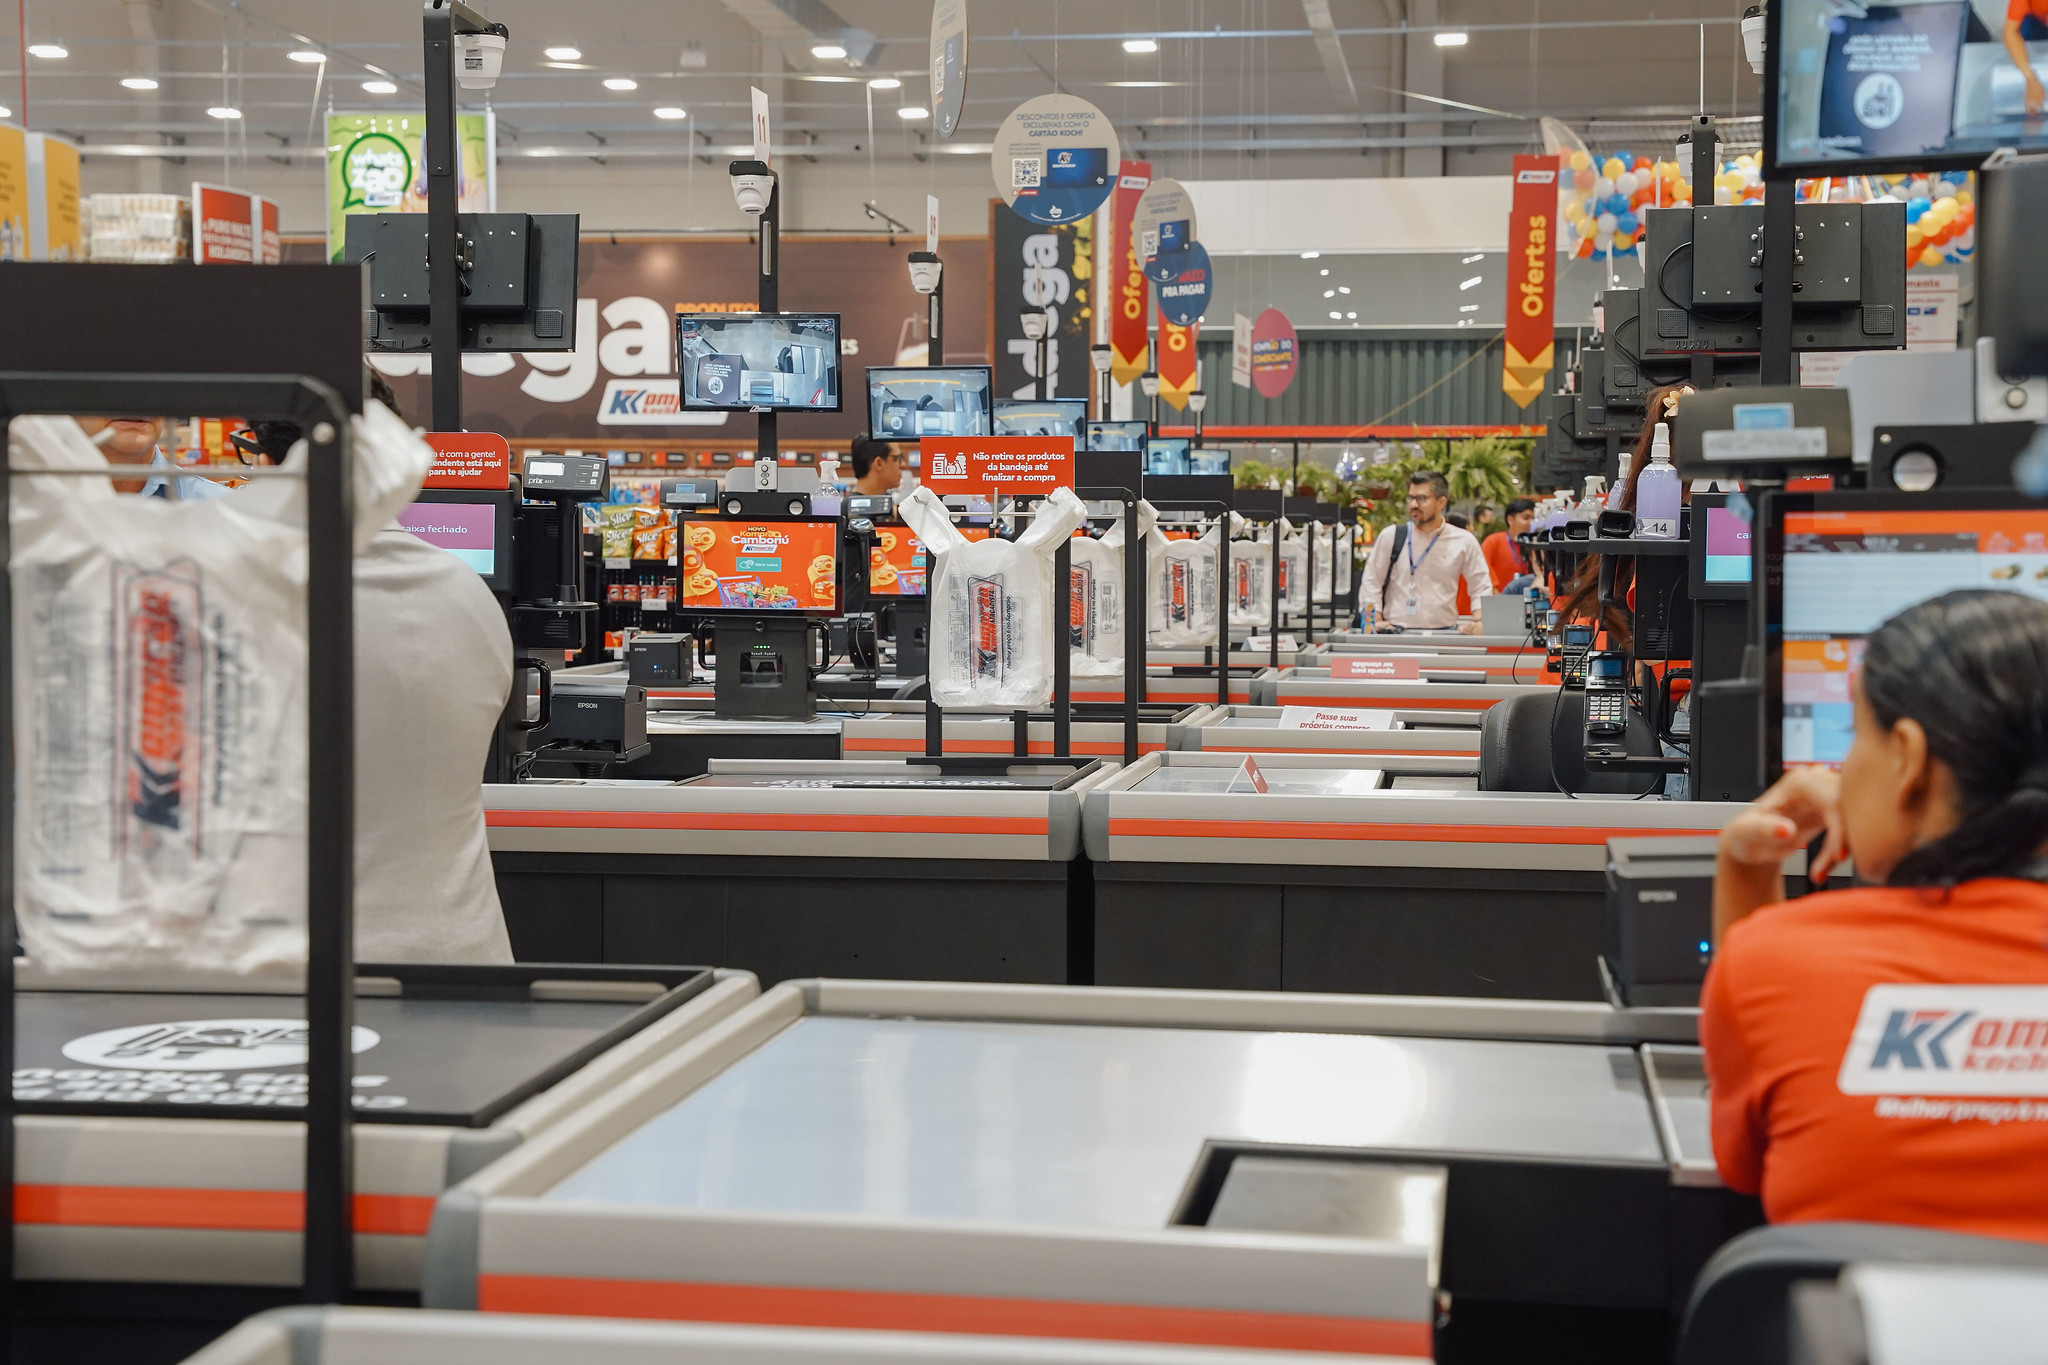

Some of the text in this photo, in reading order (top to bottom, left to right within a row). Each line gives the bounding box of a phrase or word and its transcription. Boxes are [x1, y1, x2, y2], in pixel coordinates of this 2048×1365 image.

[1066, 112, 1096, 120] OFERTAS
[757, 113, 766, 144] 11
[1520, 214, 1547, 318] Ofertas
[1178, 283, 1206, 297] PAGAR
[439, 449, 444, 458] é
[470, 450, 496, 459] gente!
[972, 451, 990, 461] Não
[991, 452, 1014, 461] retire
[1026, 452, 1065, 462] produtos
[431, 458, 502, 468] endente está aqui
[987, 461, 1048, 472] da bandeja até
[428, 467, 483, 477] para te ajudar
[981, 472, 1016, 481] finalizar
[1023, 474, 1056, 483] compra
[528, 477, 543, 485] prix
[609, 512, 632, 527] Slice
[639, 515, 658, 527] Slice
[427, 524, 468, 534] fechado
[1653, 522, 1668, 533] 14
[605, 530, 629, 543] Slice
[636, 532, 659, 544] Slice
[731, 534, 790, 545] Camboriú
[1315, 712, 1358, 722] Passe suas
